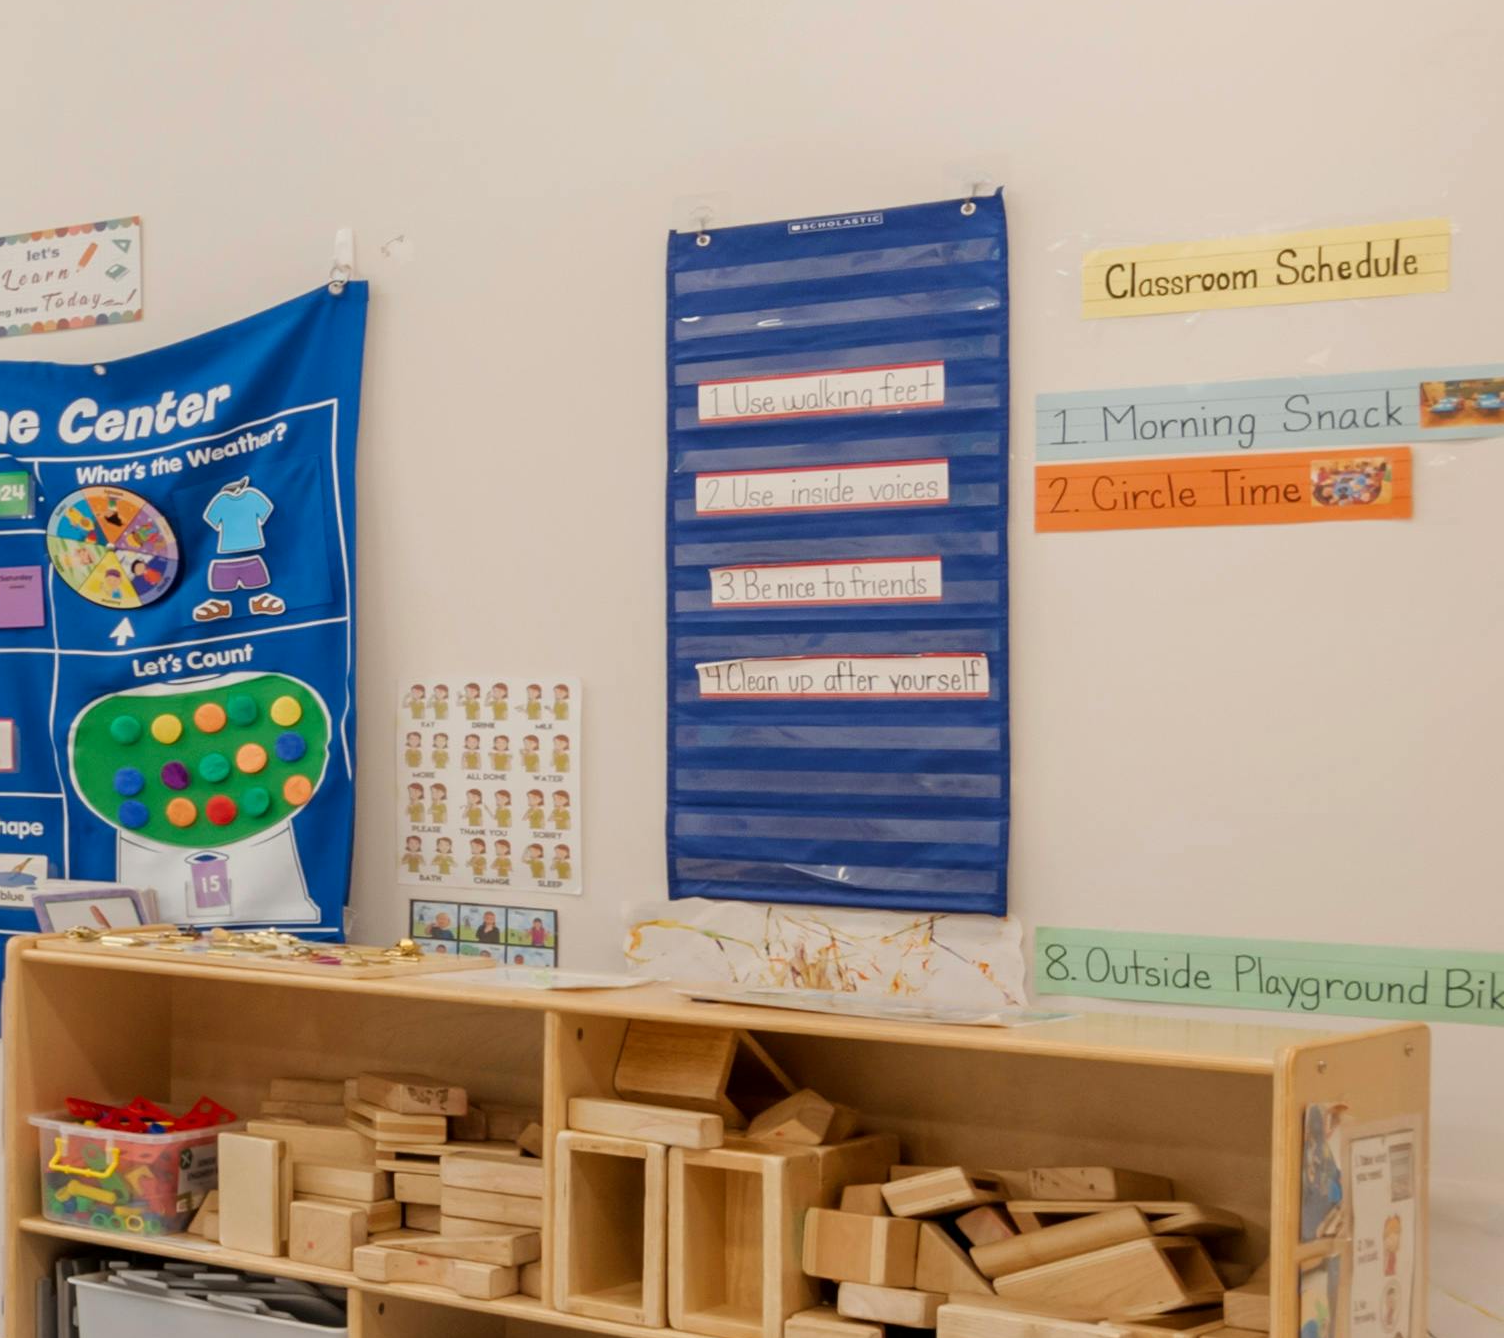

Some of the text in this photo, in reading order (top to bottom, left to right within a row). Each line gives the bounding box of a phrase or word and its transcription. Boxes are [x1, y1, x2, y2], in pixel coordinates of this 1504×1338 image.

[800, 213, 881, 231] SCHOLASTIC
[26, 247, 60, 262] let's
[1104, 238, 1419, 300] Classroom Schedule
[1, 267, 70, 291] Learn
[14, 305, 38, 316] New
[732, 384, 775, 414] Use
[781, 378, 872, 410] walking
[878, 368, 935, 402] feet
[57, 382, 232, 446] Center
[1048, 389, 1404, 450] 1. Morning Snack
[76, 422, 288, 486] What's the Weather?
[704, 473, 939, 510] 2. Use inside voices
[1048, 467, 1303, 515] 2. Circle Time
[0, 574, 32, 583] Saturday
[718, 565, 928, 601] 3. Be nice to friends
[132, 643, 255, 679] Let's Count
[705, 659, 981, 695] 4. Clean up after yourself
[420, 721, 436, 729] EAT
[471, 722, 496, 730] DRINK
[411, 771, 436, 779] MORE
[466, 773, 507, 782] ALL DONE
[533, 774, 564, 783] WATER
[411, 825, 443, 834] PLEASE
[459, 828, 508, 837] THANK YOU
[532, 831, 563, 840] SORRY
[200, 874, 221, 894] 15
[419, 874, 442, 882] BATH
[473, 876, 511, 886] CHANGE
[537, 880, 563, 889] SLEEP
[0, 890, 25, 903] blue
[1043, 943, 1078, 982] 8.
[1085, 946, 1213, 991] Outside
[1234, 954, 1429, 1012] Playground
